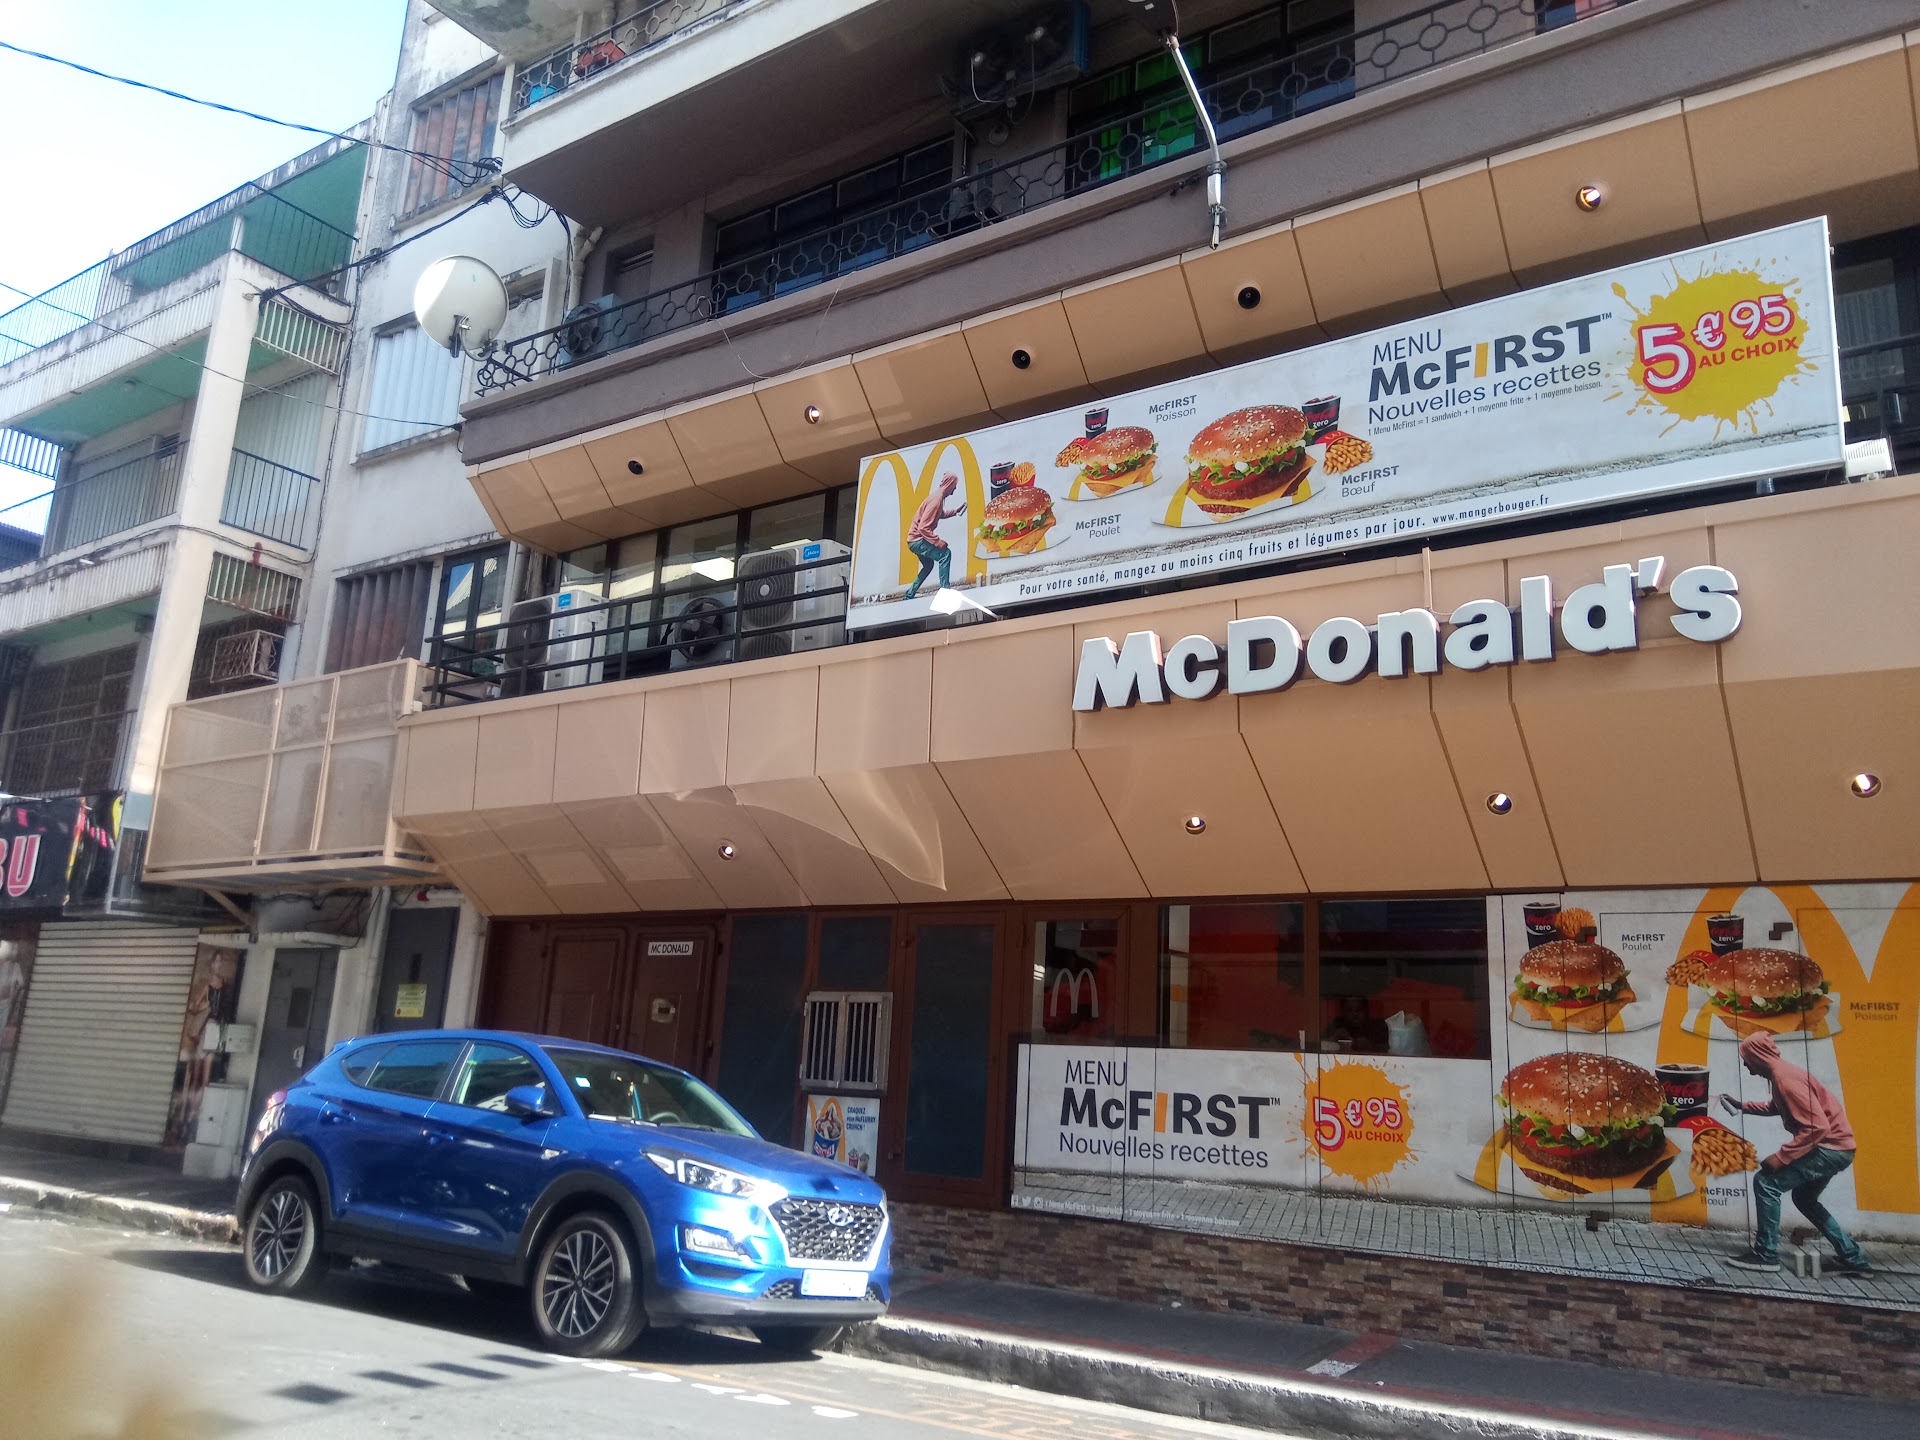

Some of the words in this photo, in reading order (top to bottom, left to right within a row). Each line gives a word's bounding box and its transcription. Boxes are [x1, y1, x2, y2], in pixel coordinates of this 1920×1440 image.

[1372, 329, 1442, 366] MENU
[1698, 350, 1726, 369] AU
[1731, 336, 1799, 362] CHOIX
[1368, 383, 1486, 425] Nouvelles
[1493, 361, 1601, 398] recettes
[1149, 394, 1197, 414] McFIRST
[1374, 424, 1391, 436] Menu
[1392, 419, 1417, 432] McFirst
[1431, 409, 1462, 423] sandwich
[1477, 401, 1508, 414] moyenne
[1510, 396, 1524, 407] frite
[1541, 387, 1572, 401] moyenne
[1574, 380, 1602, 393] boisson.
[1155, 406, 1196, 423] Poisson
[1312, 419, 1329, 429] zero
[1341, 465, 1399, 485] McFIRST
[1341, 482, 1375, 497] Bœuf
[1075, 514, 1121, 531] McFIRST
[1089, 526, 1121, 539] Poulet
[1019, 583, 1042, 595] Pour
[1046, 577, 1072, 590] votre
[1077, 570, 1109, 586] santé,
[1114, 564, 1156, 580] mangez
[1161, 562, 1174, 572] au
[1180, 554, 1213, 569] moins
[1219, 548, 1242, 561] cinq
[1248, 540, 1282, 556] fruits
[1288, 535, 1299, 549] et
[1305, 528, 1359, 548] légumes
[1365, 523, 1387, 538] par
[1393, 515, 1425, 533] jour.
[1432, 494, 1549, 524] www.mangerbouger.fr
[1072, 555, 1742, 713] McDonald's
[1621, 933, 1666, 941] McFIRST
[650, 944, 661, 954] MC
[662, 944, 690, 954] DONALD
[1622, 942, 1652, 951] Poulet
[1850, 1002, 1900, 1011] McFIRST
[1854, 1012, 1898, 1021] Poisson
[1065, 1059, 1126, 1087] MENU
[1672, 1096, 1695, 1106] zero
[1347, 1130, 1362, 1140] AU
[1365, 1131, 1405, 1143] CHOIX
[1060, 1131, 1164, 1160] Nouvelles
[1170, 1144, 1269, 1168] recettes
[1700, 1186, 1747, 1197] McFIRST
[1700, 1196, 1728, 1206] Bœuf
